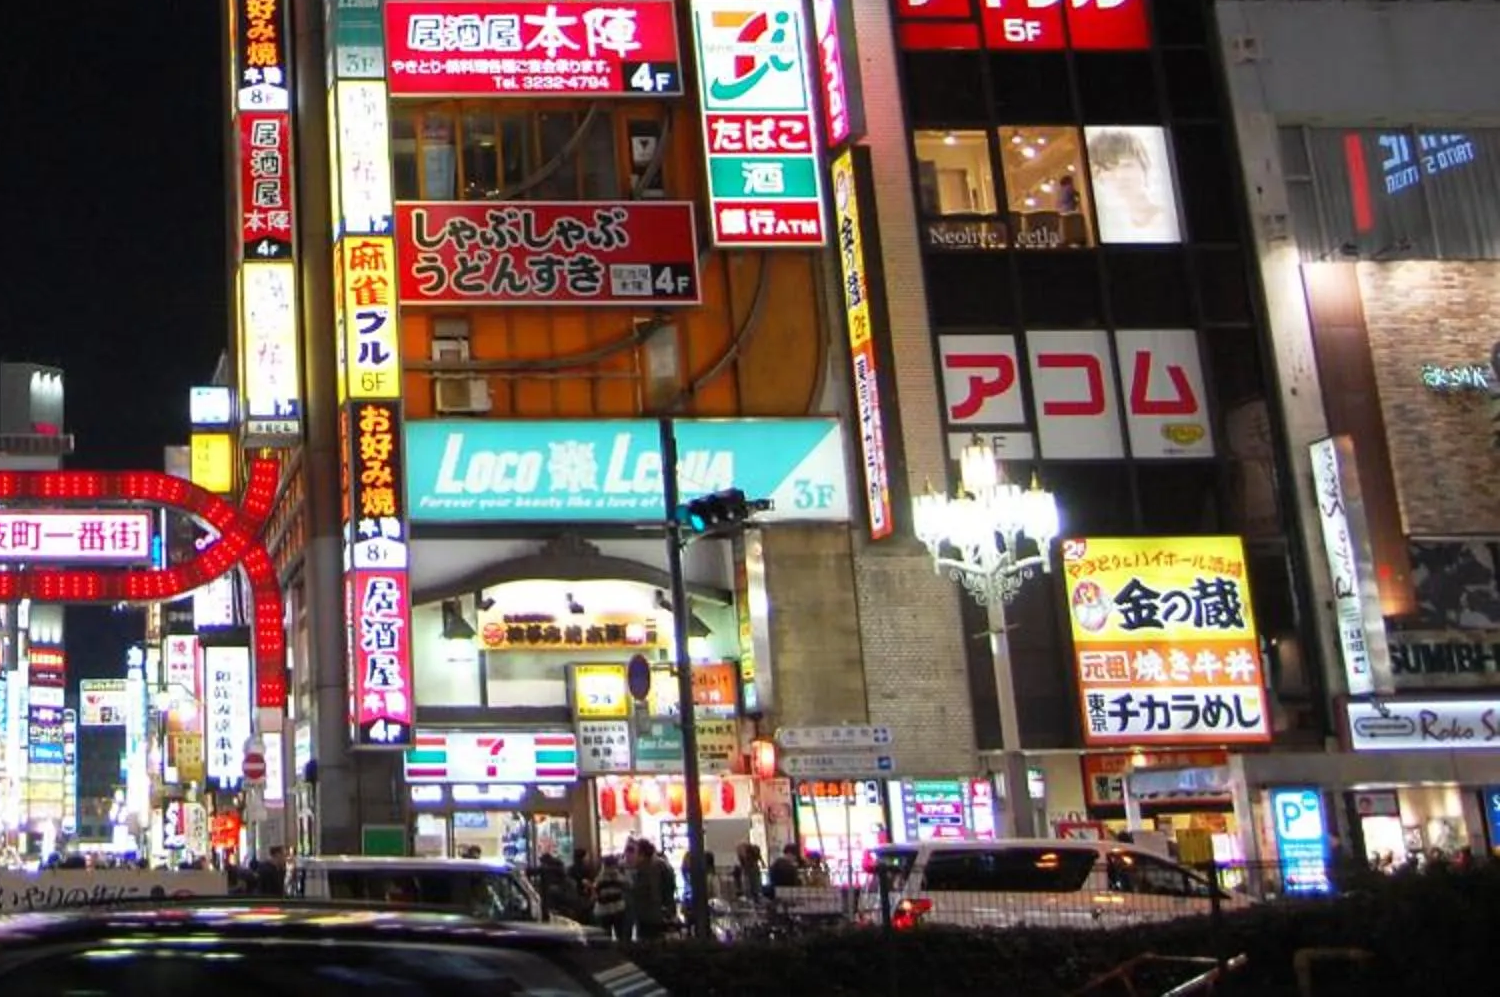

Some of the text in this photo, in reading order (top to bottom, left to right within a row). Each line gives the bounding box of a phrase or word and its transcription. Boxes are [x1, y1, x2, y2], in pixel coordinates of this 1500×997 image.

[407, 4, 642, 59] 居酒屋本陣
[1002, 20, 1041, 42] 5F
[631, 63, 670, 93] 4F
[711, 117, 809, 151] たばこ
[251, 120, 283, 207] 居酒屋
[740, 160, 785, 195] 酒
[243, 210, 291, 231] 本陣
[411, 207, 628, 251] しゃぶしゃぶ
[256, 239, 280, 256] 4F
[412, 251, 603, 297] うどんすき
[654, 267, 690, 294] 4F
[944, 350, 1198, 420] アコム
[359, 405, 396, 515] お好み焼
[793, 480, 836, 510] 3F
[1113, 577, 1245, 630] 金の蔵
[362, 576, 404, 691] 居酒屋
[1082, 648, 1256, 682] 元祖 焼き牛丼
[1086, 693, 1261, 732] 東京 チカラめし
[1419, 708, 1475, 742] Roko
